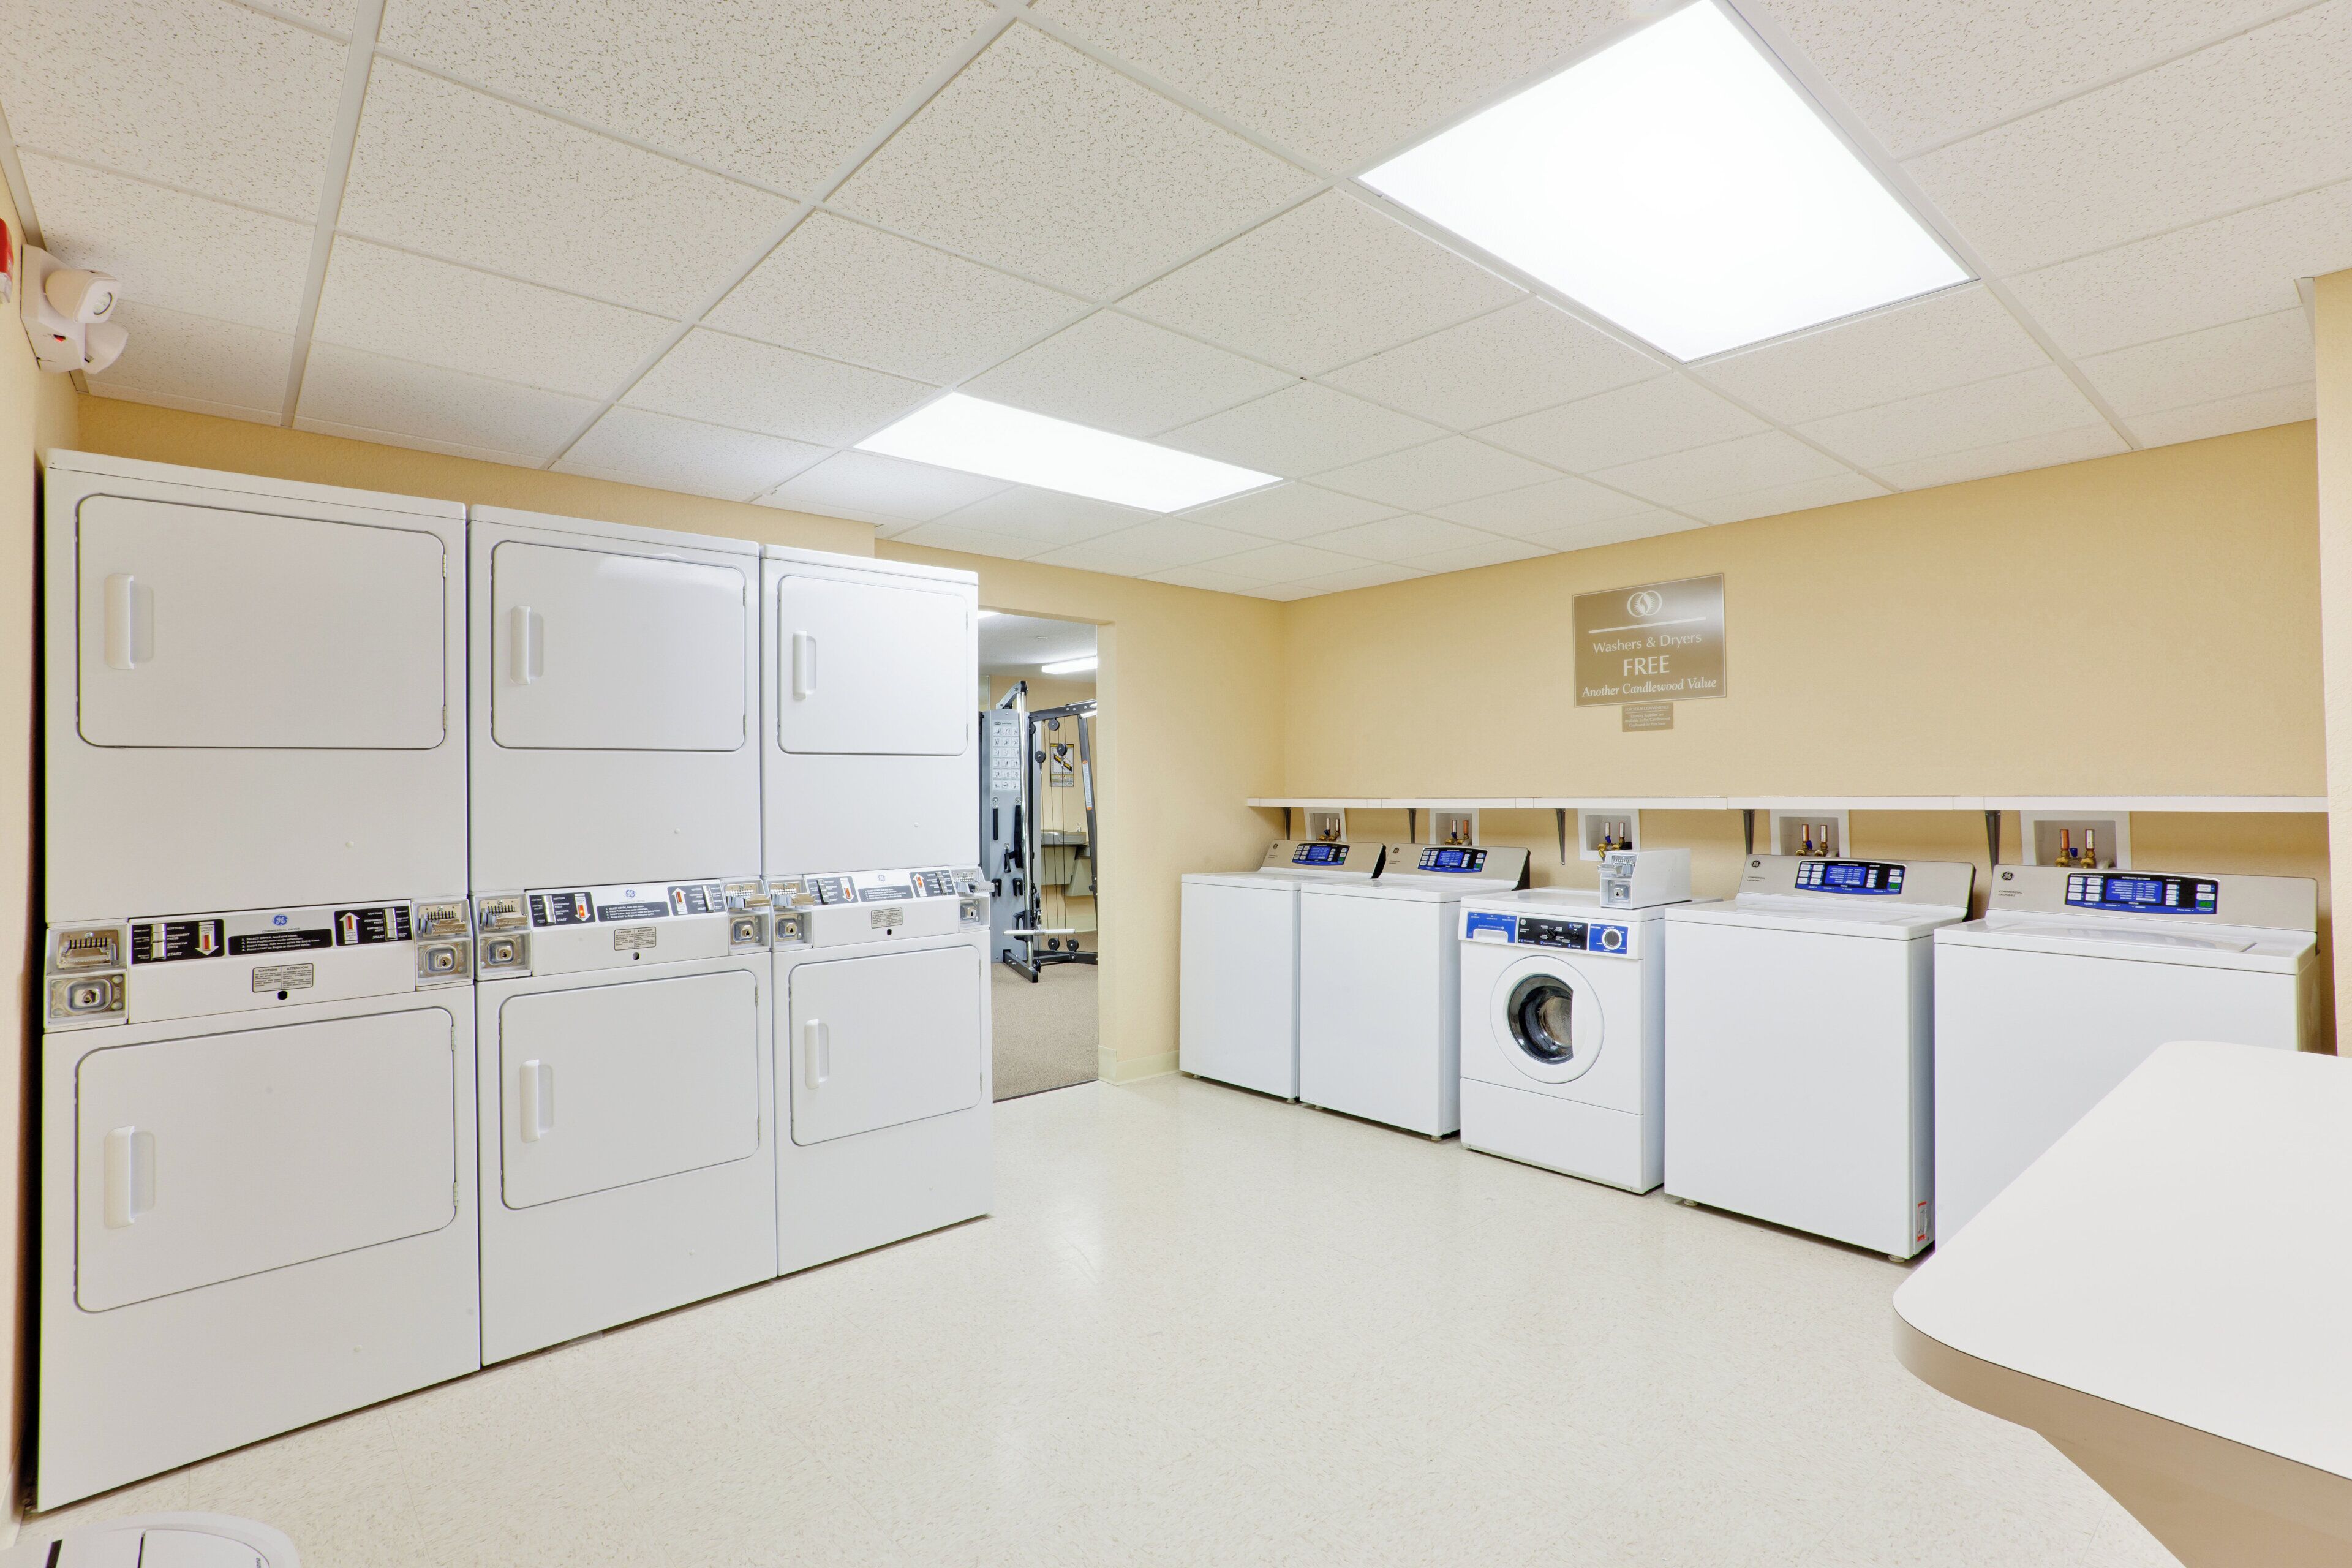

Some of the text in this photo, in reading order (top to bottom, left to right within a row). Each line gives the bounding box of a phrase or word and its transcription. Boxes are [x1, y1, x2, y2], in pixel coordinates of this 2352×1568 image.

[1593, 633, 1702, 653] Washers & Dryers
[1623, 655, 1670, 676] FREE
[1581, 677, 1716, 697] Another Candlewood Value
